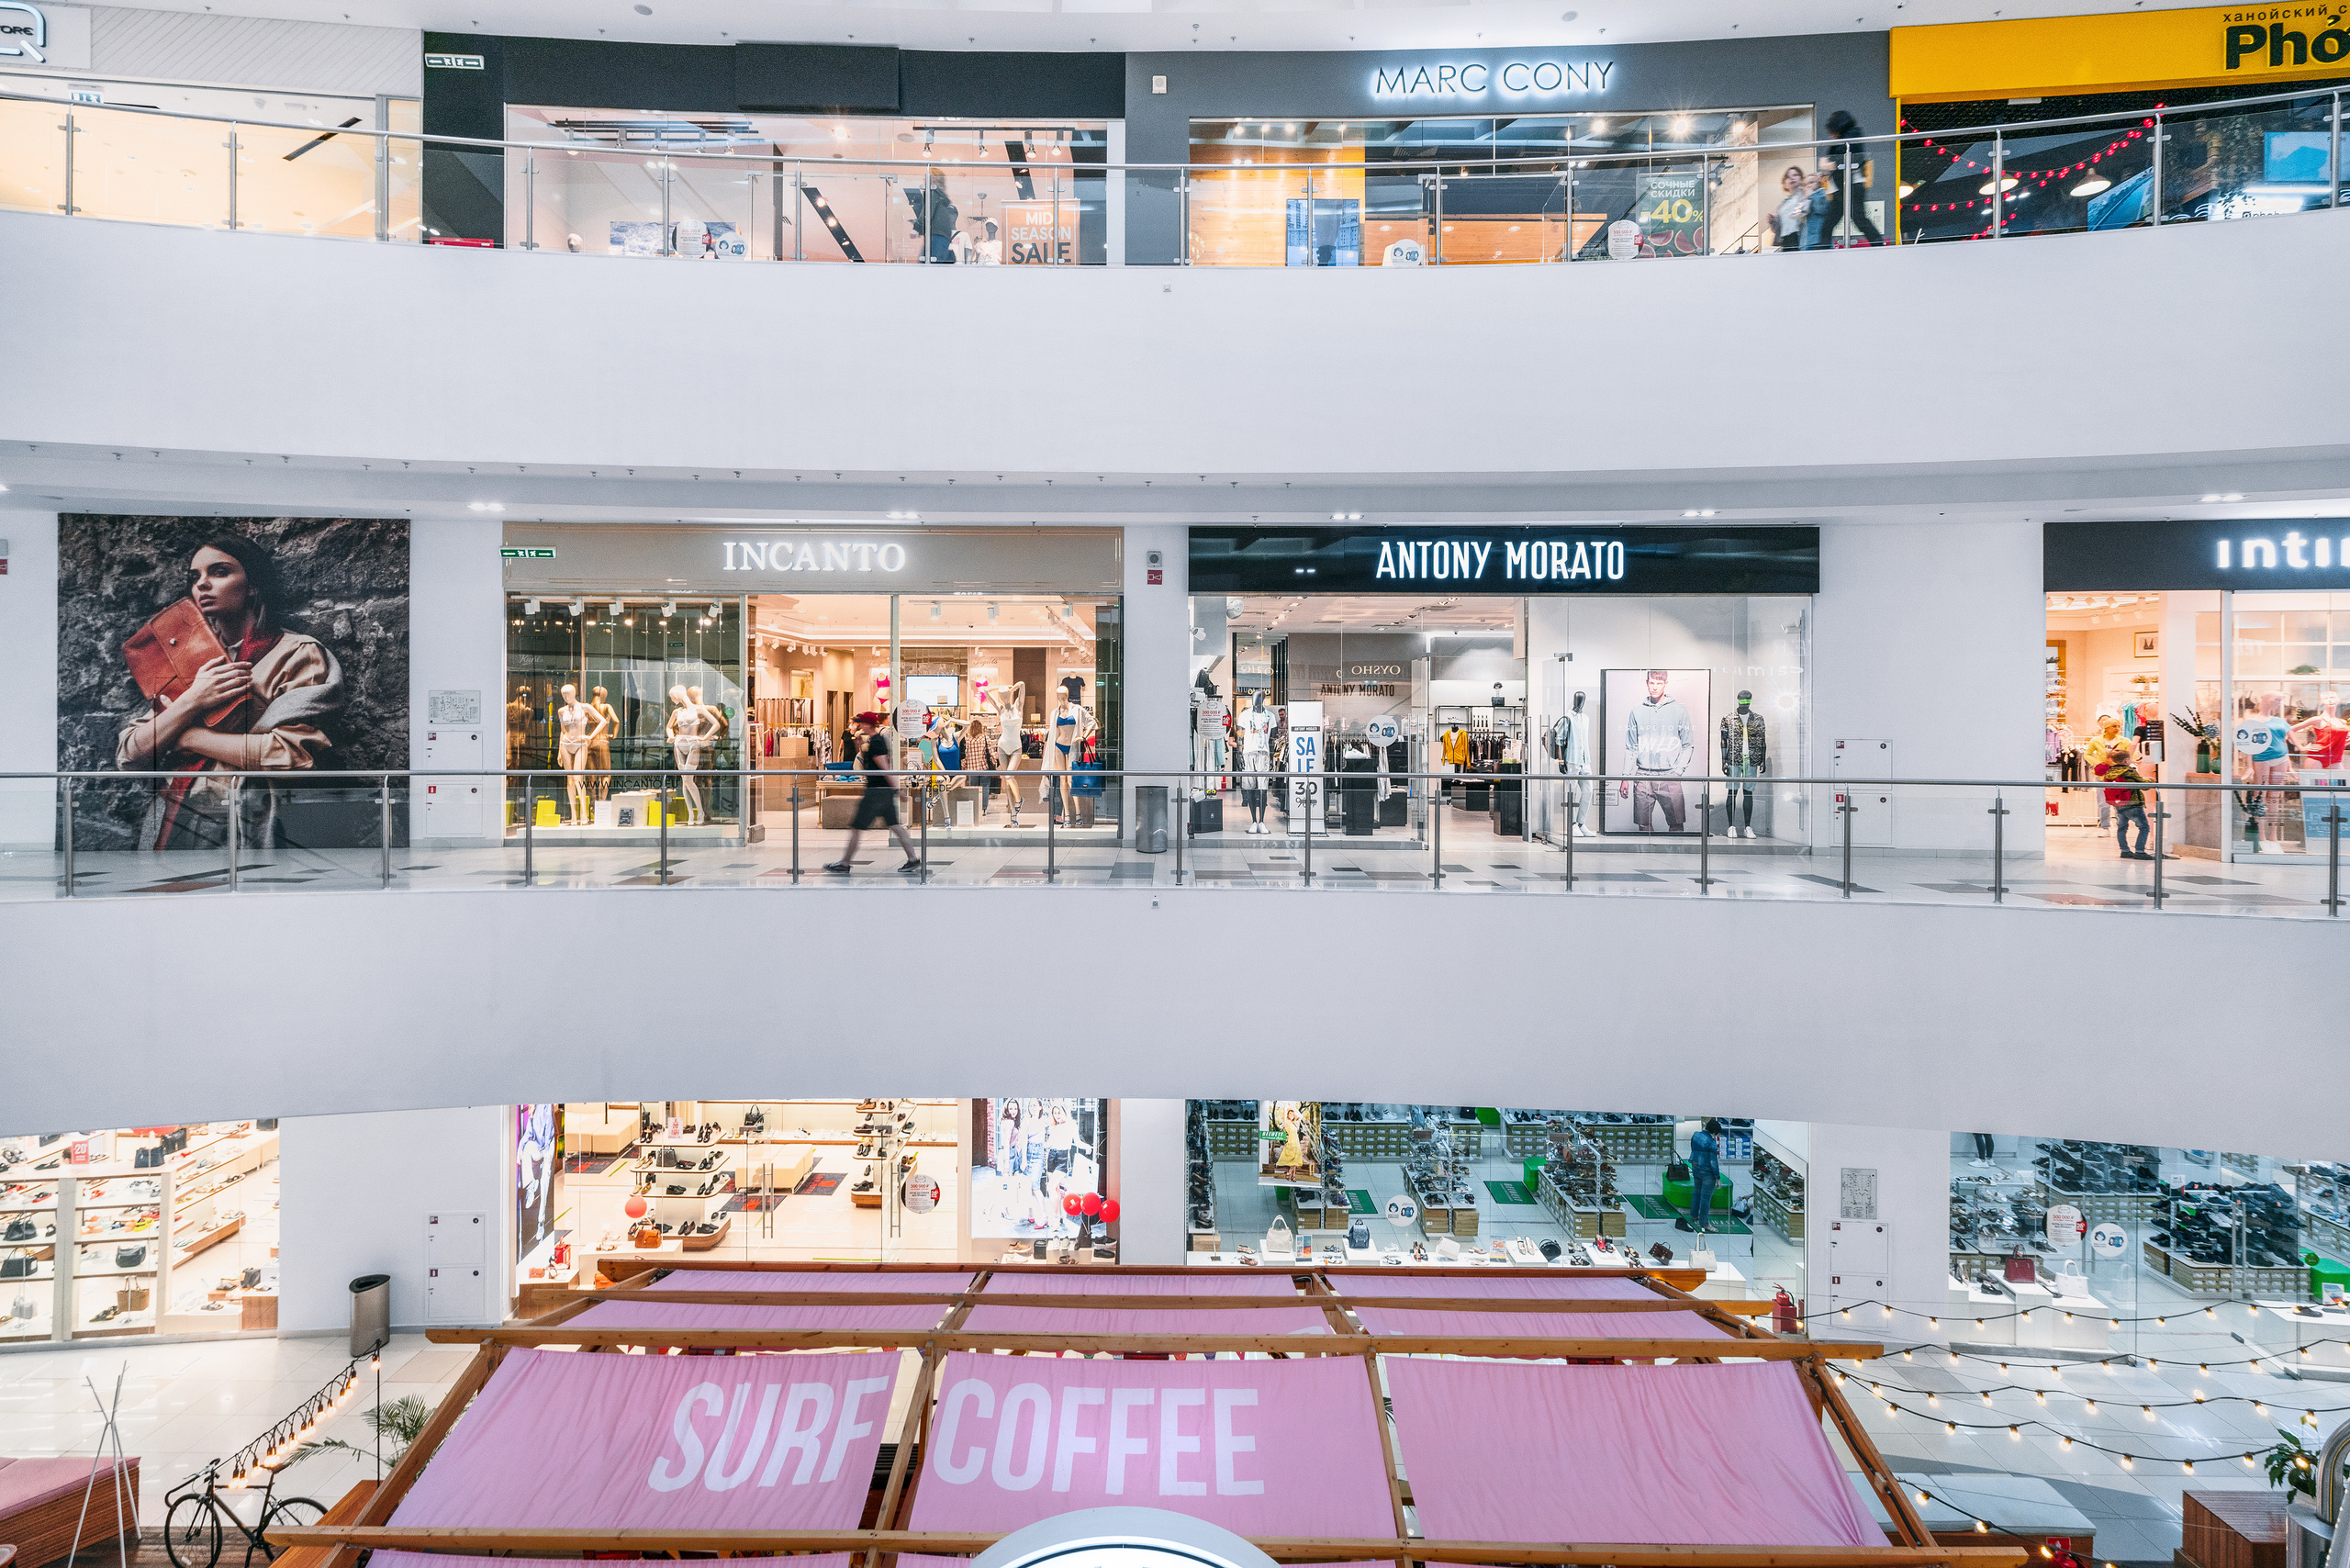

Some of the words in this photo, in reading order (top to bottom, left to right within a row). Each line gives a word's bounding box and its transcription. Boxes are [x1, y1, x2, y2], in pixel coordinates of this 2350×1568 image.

[2223, 4, 2328, 23] ханойский
[0, 25, 34, 36] ORE
[1376, 63, 1487, 94] MARC
[1503, 61, 1614, 92] CONY
[1650, 180, 1695, 189] СОЧНЫЕ
[1650, 189, 1695, 198] СКИДКИ
[1025, 211, 1053, 226] MID
[1011, 227, 1071, 241] SEASON
[722, 542, 906, 572] INCANTO
[2217, 532, 2350, 568] inti
[1376, 541, 1492, 579] ANTONY
[1505, 541, 1624, 579] MORATO
[1320, 684, 1356, 698] ANTONY
[1359, 684, 1395, 697] MORATO
[1295, 736, 1315, 756] SA
[578, 780, 679, 790] WWW.INCANTOEU
[1295, 781, 1317, 796] 30
[648, 1376, 890, 1493] SURF
[933, 1378, 1265, 1496] COFFEE
